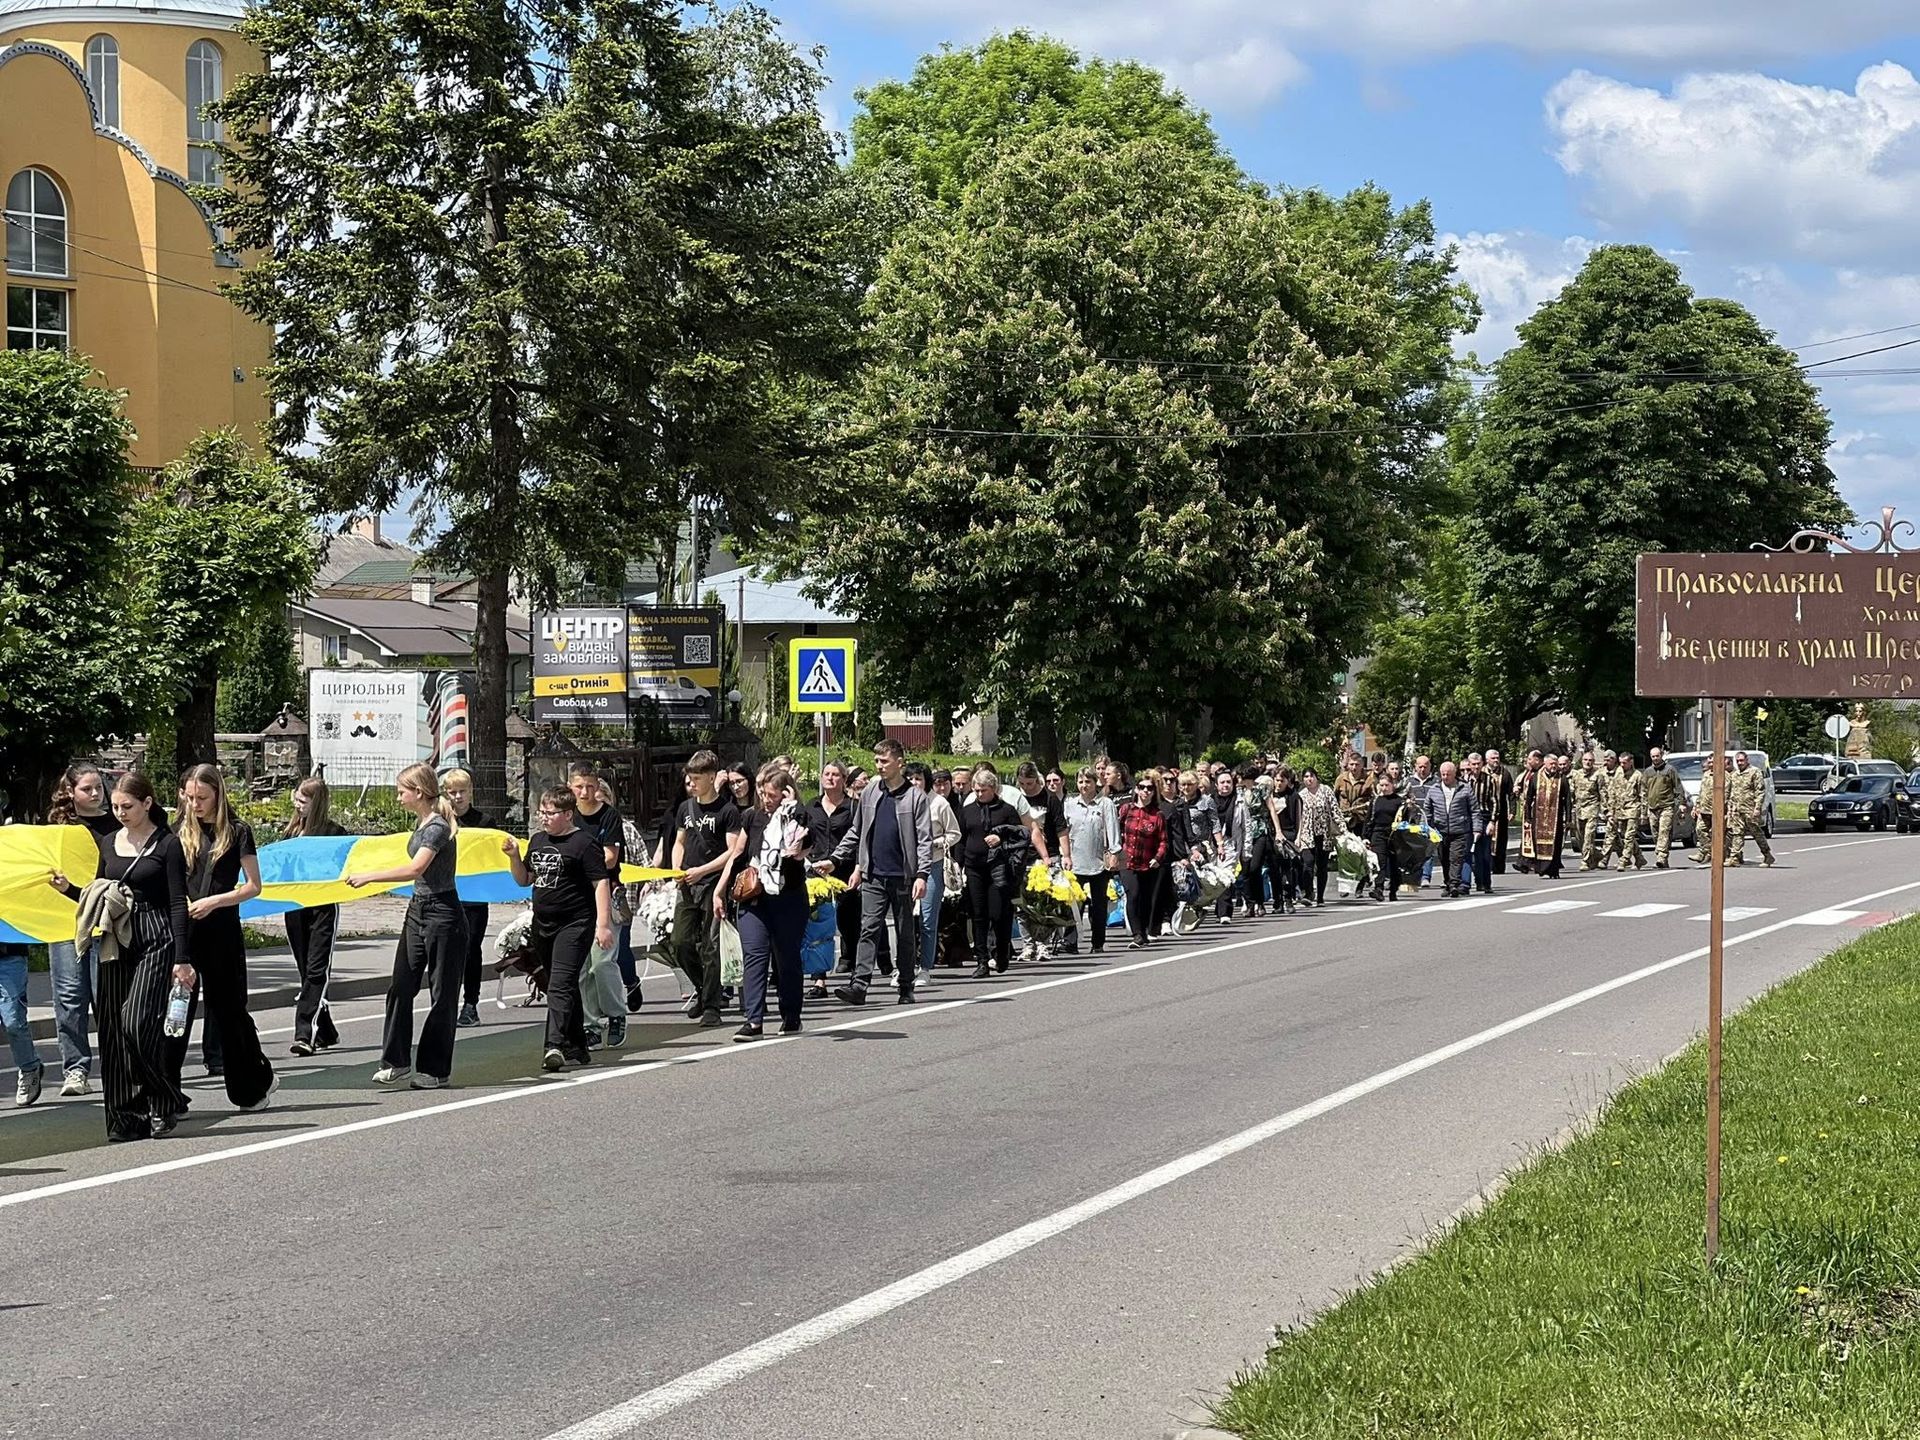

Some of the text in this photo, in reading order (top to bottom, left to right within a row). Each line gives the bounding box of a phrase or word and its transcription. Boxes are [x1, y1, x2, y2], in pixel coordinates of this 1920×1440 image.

[1656, 567, 1843, 603] Православна
[660, 616, 710, 624] ЗАМОВЛЕНЬ
[1863, 606, 1920, 625] Храм
[541, 617, 624, 639] ЦЕНТР
[568, 640, 614, 654] видачі
[1660, 631, 1769, 664] Введення
[1778, 639, 1790, 658] в
[1797, 639, 1856, 668] храм
[543, 654, 619, 664] замовлень
[570, 676, 609, 689] Отинія
[1852, 674, 1892, 688] 1877
[322, 683, 405, 697] ЦИРЮЛЬНЯ
